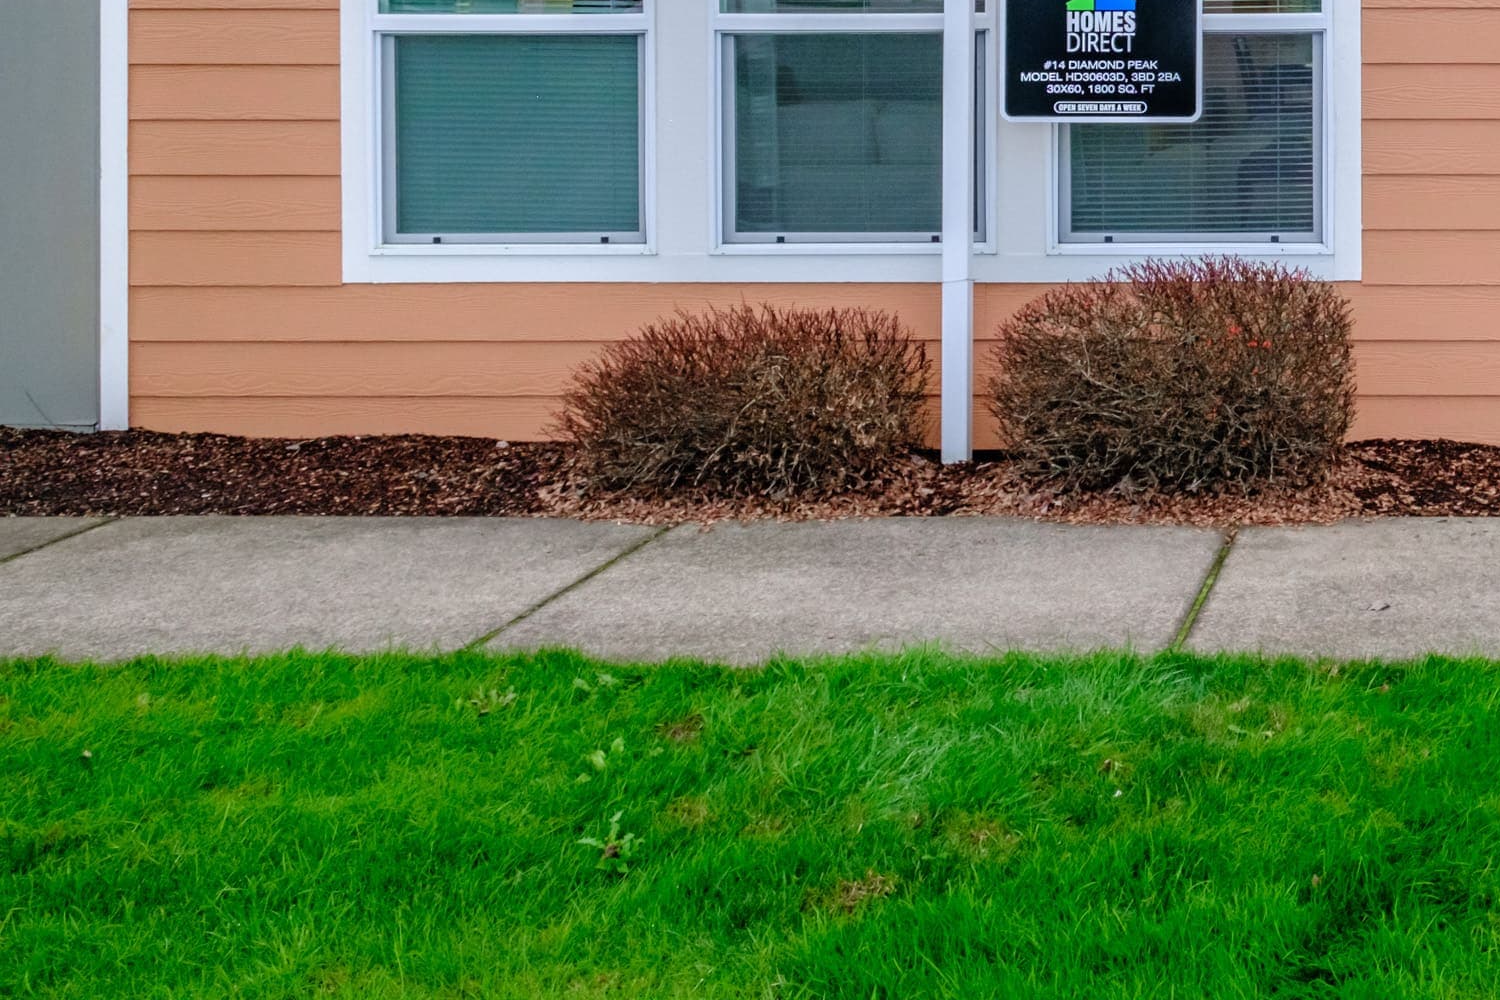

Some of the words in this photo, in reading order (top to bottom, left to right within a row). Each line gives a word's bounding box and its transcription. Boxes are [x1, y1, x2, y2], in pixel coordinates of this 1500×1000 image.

[1065, 11, 1136, 33] HOMES
[1066, 32, 1136, 53] DIRECT
[1043, 60, 1066, 70] #14
[1068, 60, 1125, 70] DIAMOND
[1127, 60, 1158, 70] PEAK
[1020, 72, 1063, 82] MODEL
[1065, 72, 1129, 83] HD30603D,
[1131, 72, 1155, 82] 3BD
[1157, 72, 1181, 82] 2BA
[1046, 84, 1085, 95] 30X60,
[1088, 84, 1115, 94] 1800
[1117, 84, 1138, 94] SQ.
[1141, 84, 1155, 94] FT
